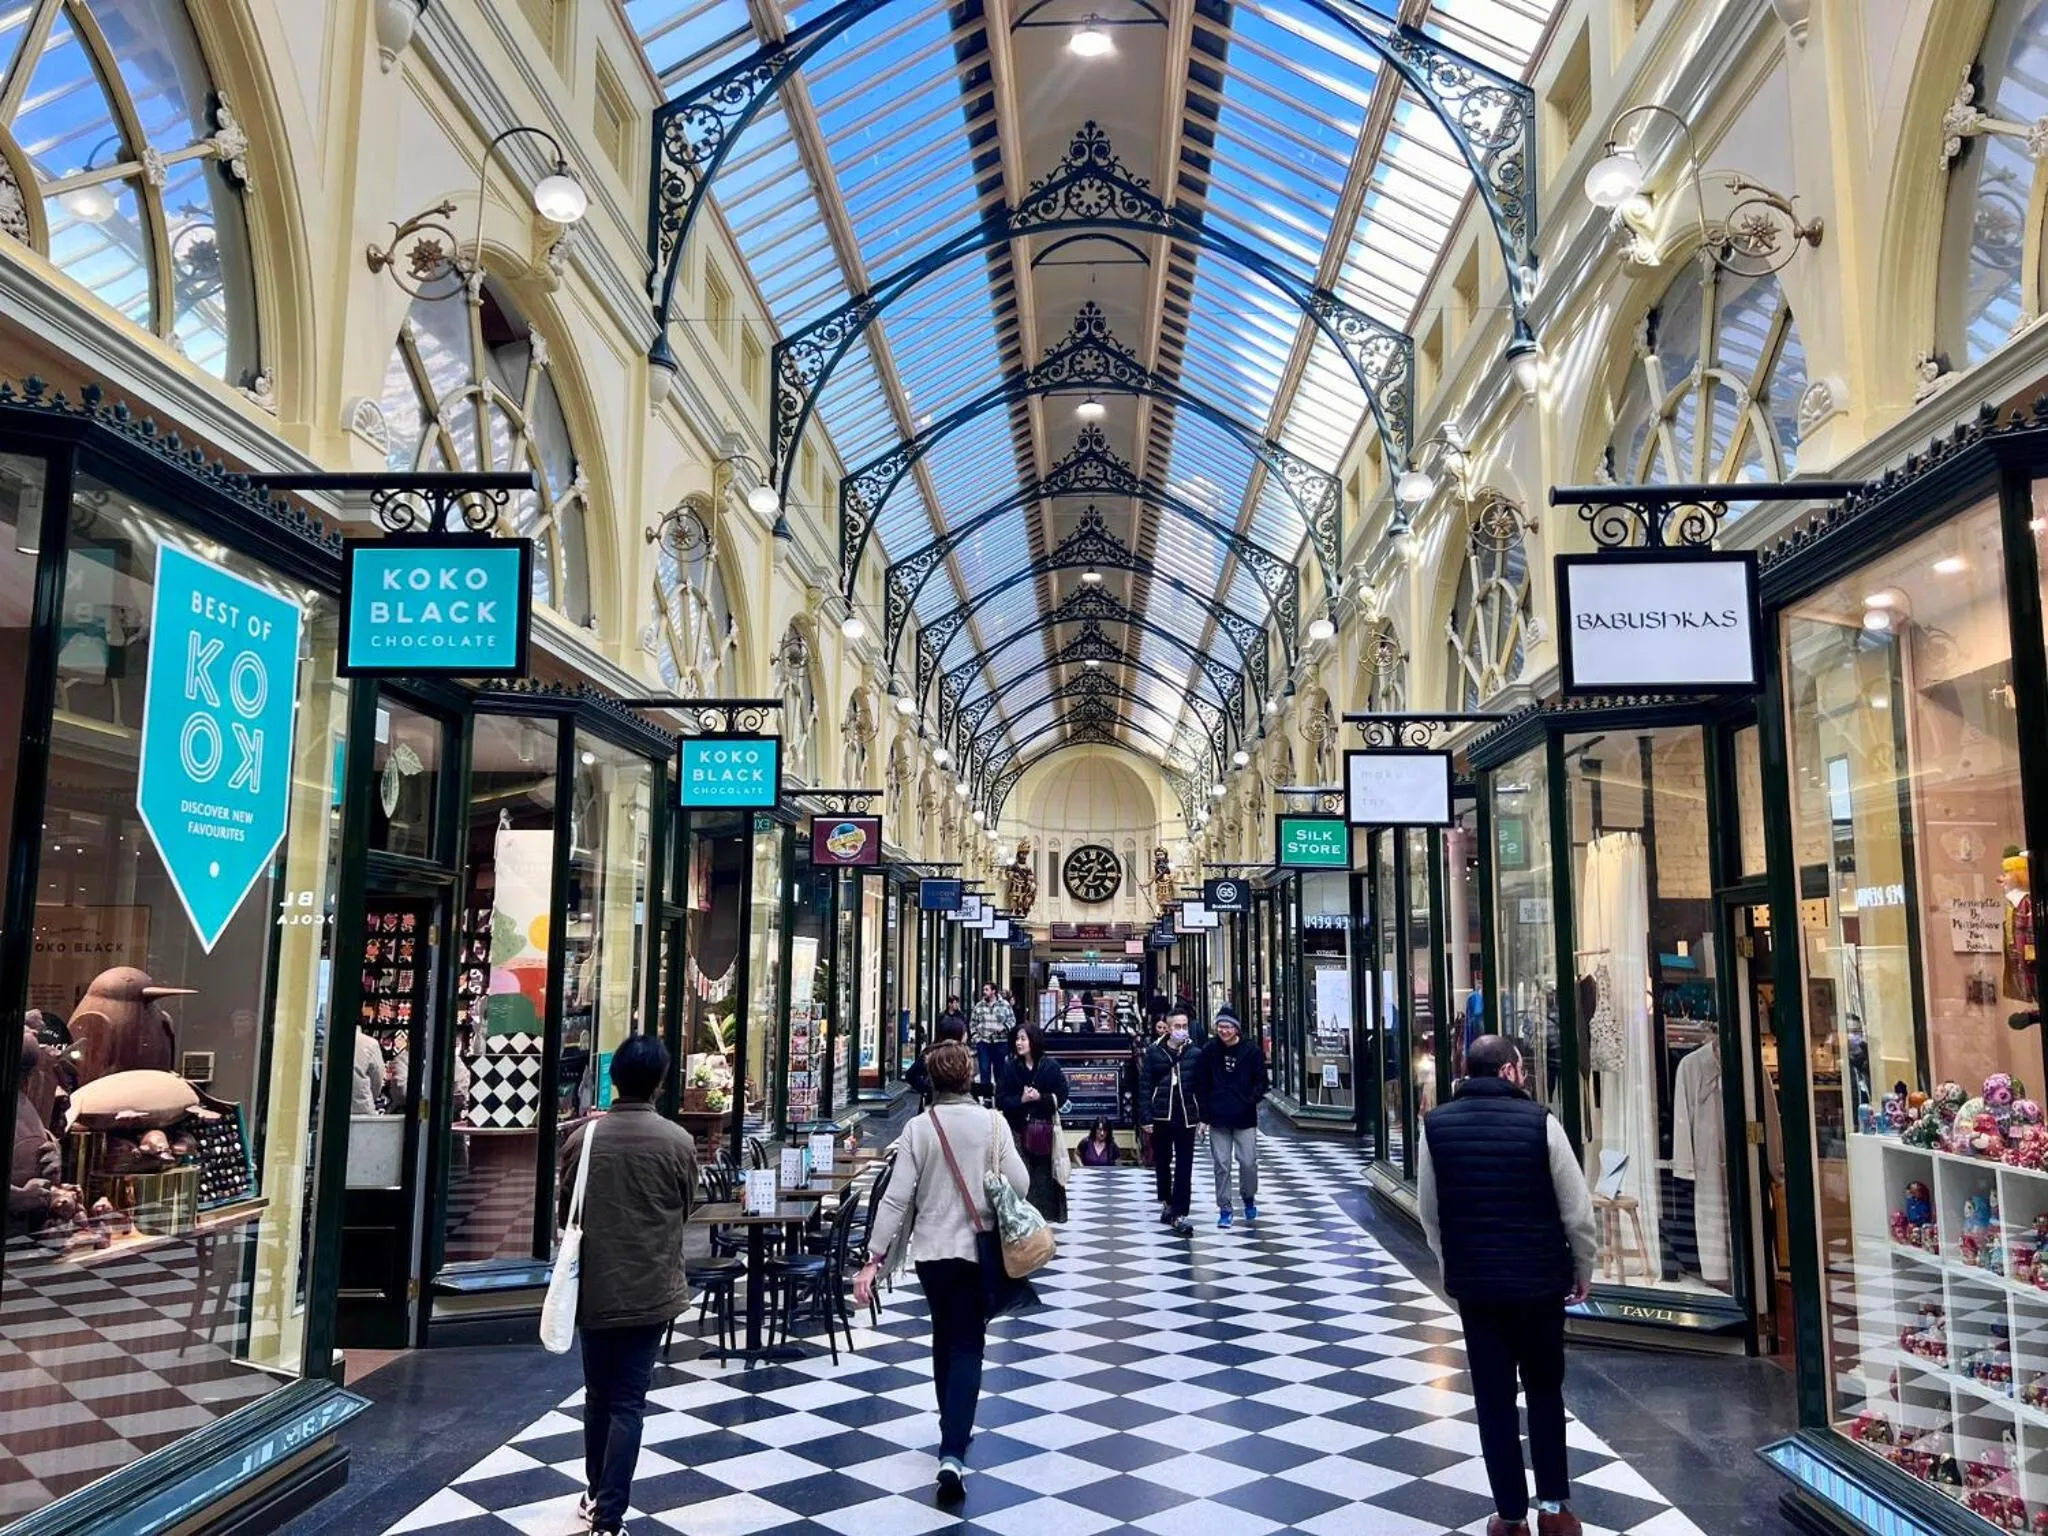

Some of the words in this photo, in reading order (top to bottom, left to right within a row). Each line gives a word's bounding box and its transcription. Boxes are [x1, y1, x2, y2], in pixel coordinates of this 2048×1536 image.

[383, 568, 489, 591] KOKO
[191, 589, 240, 629] BEST
[247, 615, 273, 641] OF
[370, 601, 497, 624] BLACK
[1576, 609, 1739, 630] BABUSHKAS
[371, 635, 497, 647] CHOCOLATE
[700, 750, 759, 763] KOKO
[692, 768, 764, 781] BLACK
[692, 787, 764, 795] CHOCOLATE
[181, 799, 230, 820] DISCOVER
[232, 810, 254, 824] NEW
[188, 821, 245, 842] FAVOURITES
[1296, 829, 1333, 841] SILK
[1287, 842, 1341, 854] STORE
[35, 943, 66, 953] OKO
[74, 943, 124, 953] BLACK
